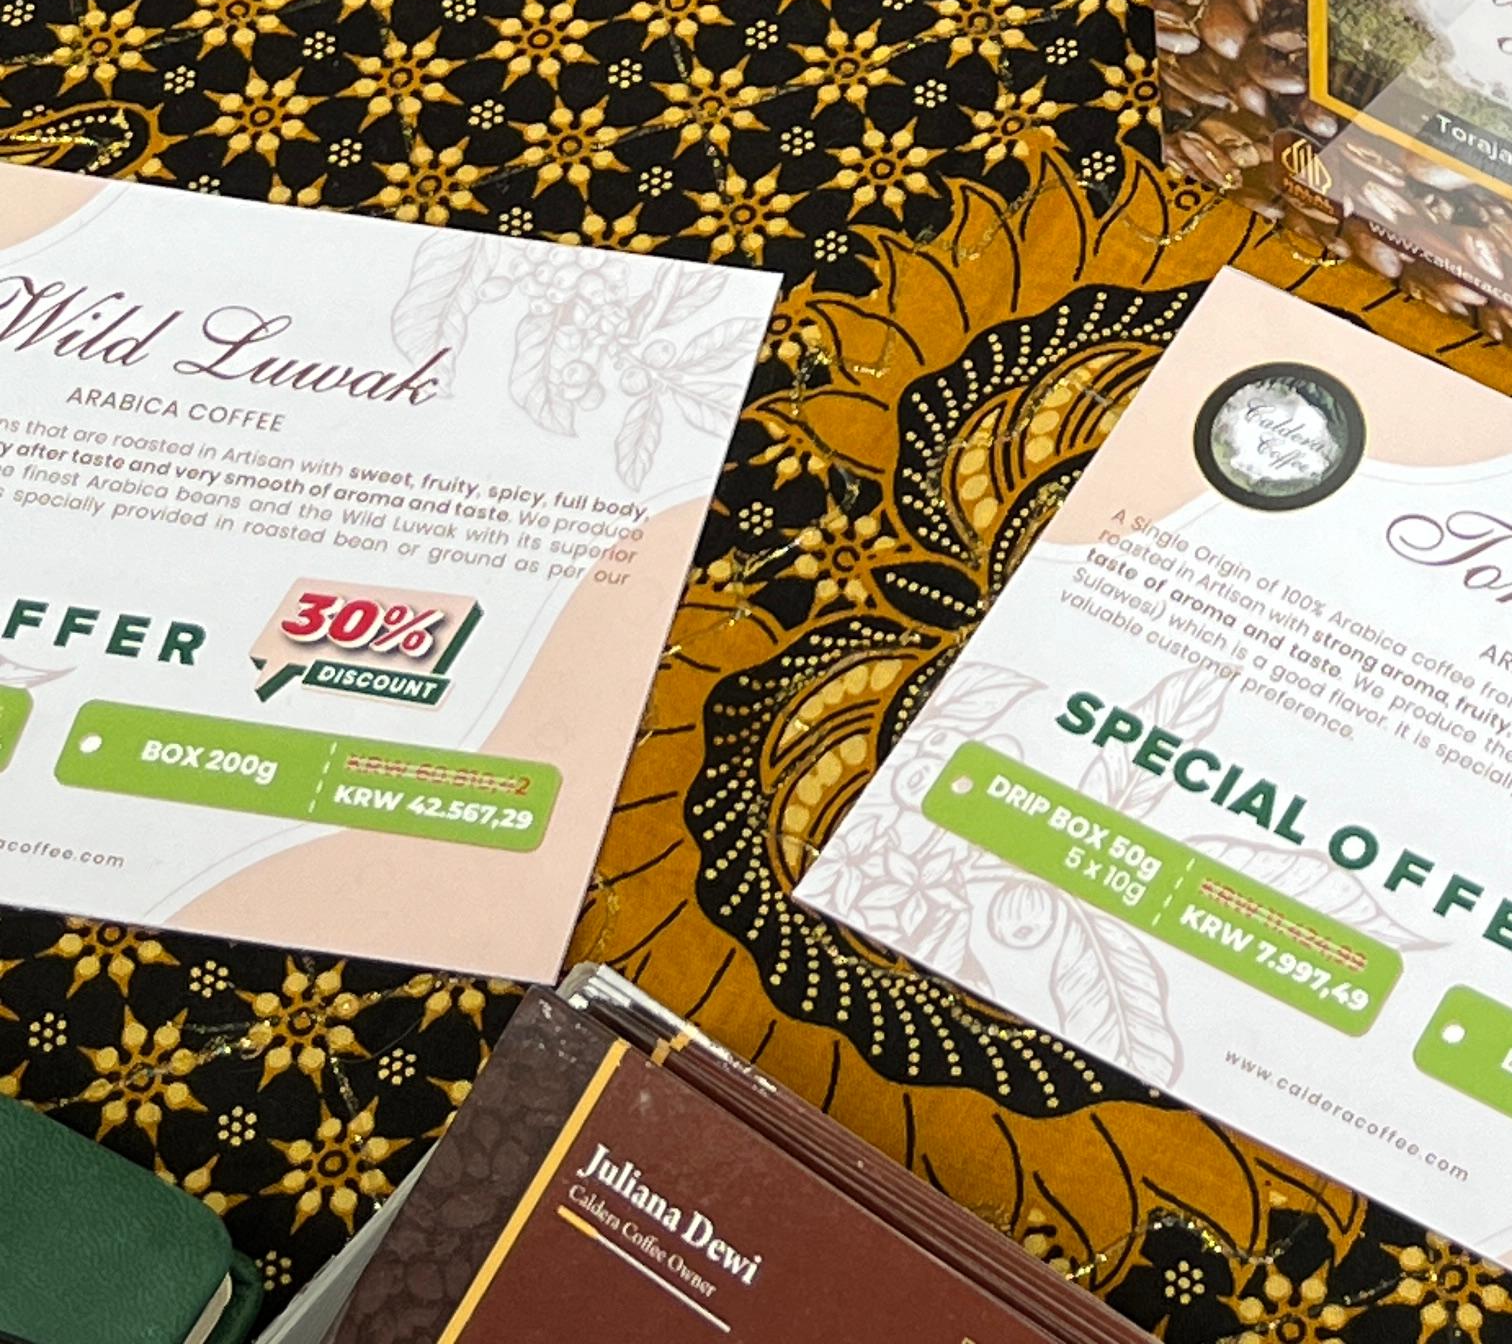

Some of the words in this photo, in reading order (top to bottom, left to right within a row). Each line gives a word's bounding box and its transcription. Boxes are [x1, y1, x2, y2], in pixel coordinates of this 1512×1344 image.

[1436, 114, 1512, 165] Toraja
[0, 274, 184, 367] Wild
[174, 304, 452, 406] Luwak
[66, 387, 178, 418] ARABICA
[188, 401, 286, 433] COFFEE
[15, 441, 69, 462] after
[70, 448, 125, 470] taste
[127, 458, 173, 476] and
[174, 464, 222, 487] very
[222, 471, 305, 495] smooth
[307, 481, 333, 499] of
[332, 487, 406, 509] aroma
[407, 497, 452, 515] and
[453, 500, 512, 524] taste.
[517, 509, 551, 529] We
[551, 516, 644, 542] produce
[281, 592, 444, 656] 30%
[1096, 528, 1178, 572] roasted
[1174, 560, 1195, 583] in
[1194, 572, 1266, 616] Artisan
[1267, 607, 1310, 637] with
[1310, 628, 1379, 673] strong
[1379, 661, 1450, 709] aroma,
[1453, 694, 1512, 739] fruity,
[317, 665, 438, 698] DISCOUNT
[141, 740, 204, 768] BOX
[205, 750, 278, 785] 200g
[334, 785, 404, 811] KRW
[407, 795, 533, 829] 42.567,29
[1055, 690, 1305, 845] SPECIAL
[986, 774, 1051, 817] DRIP
[1048, 805, 1110, 849] BOX
[1109, 837, 1163, 881] 50g
[1064, 847, 1083, 870] 5
[1102, 863, 1148, 908] 10g
[1178, 904, 1255, 954] KRW
[1254, 940, 1370, 1012] 7.997,49
[1224, 1049, 1470, 1183] www.calderacoffee.com
[568, 1184, 620, 1230] Caldera
[621, 1221, 667, 1262] Coffee
[667, 1254, 717, 1298] Owner
[576, 1143, 682, 1232] Juliana
[681, 1211, 762, 1285] Dewi
